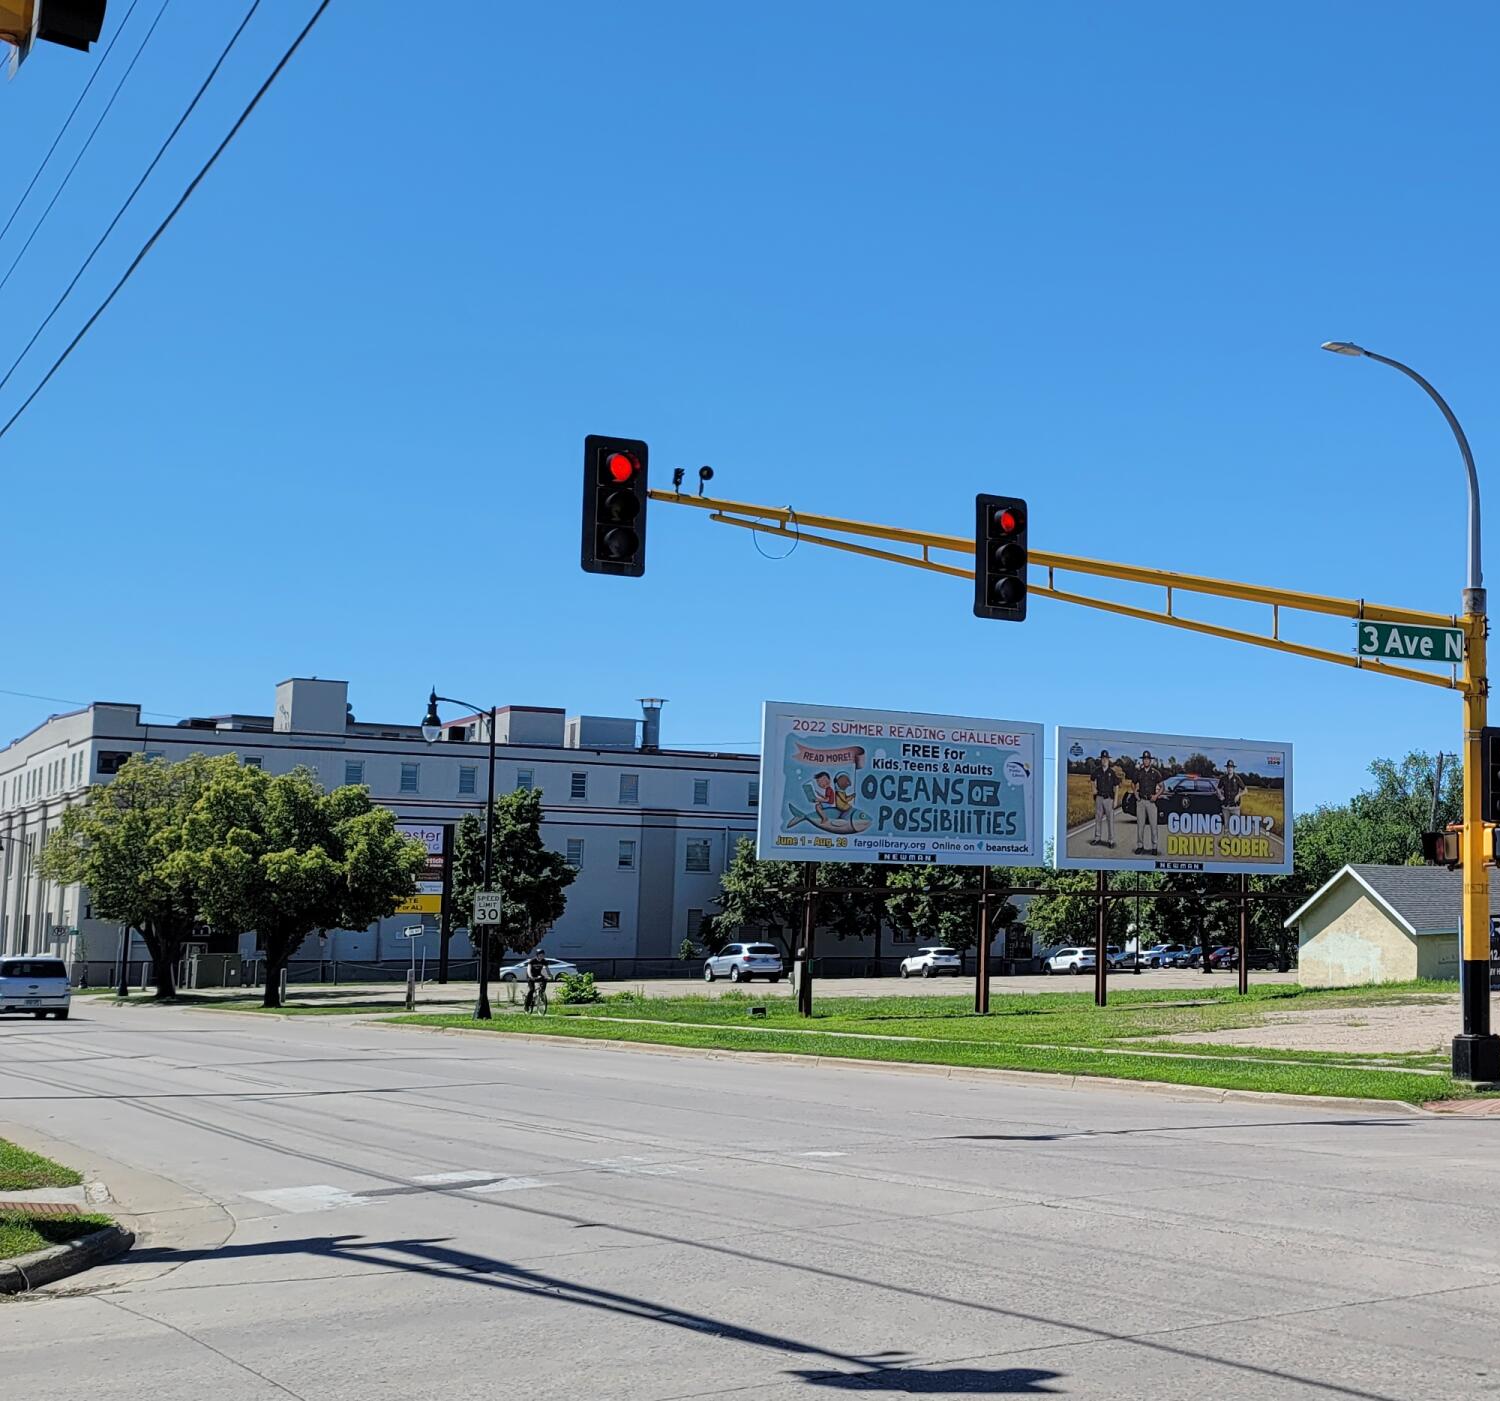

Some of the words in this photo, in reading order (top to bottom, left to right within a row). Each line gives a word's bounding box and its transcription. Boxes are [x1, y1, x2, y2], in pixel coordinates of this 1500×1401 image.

[1362, 625, 1379, 652] 3
[1384, 627, 1434, 656] Ave
[1445, 632, 1462, 659] N
[793, 719, 826, 732] 2022
[831, 722, 883, 736] SUMMER
[889, 725, 945, 740] READING
[951, 730, 1021, 746] CHALLENGE
[803, 751, 825, 762] READ
[826, 752, 851, 762] MORE!
[902, 743, 940, 758] FREE
[944, 747, 966, 760] for
[941, 763, 950, 774] &
[954, 763, 993, 776] Adults
[861, 774, 964, 805] OCEANS
[971, 785, 995, 803] OF
[1167, 812, 1223, 835] GOING
[1228, 815, 1274, 836] OUT?
[402, 829, 441, 842] ester
[776, 835, 798, 847] June
[800, 836, 806, 846] 1
[814, 836, 834, 849] Aug.
[854, 838, 926, 852] fargolibrary.org
[932, 841, 961, 851] Online
[986, 843, 1029, 853] beanstack
[1167, 835, 1214, 856] DRIVE
[1220, 837, 1274, 858] SOBER.
[884, 853, 932, 861] NEWMAN
[1159, 862, 1200, 870] NEWMAN
[476, 908, 499, 921] 30
